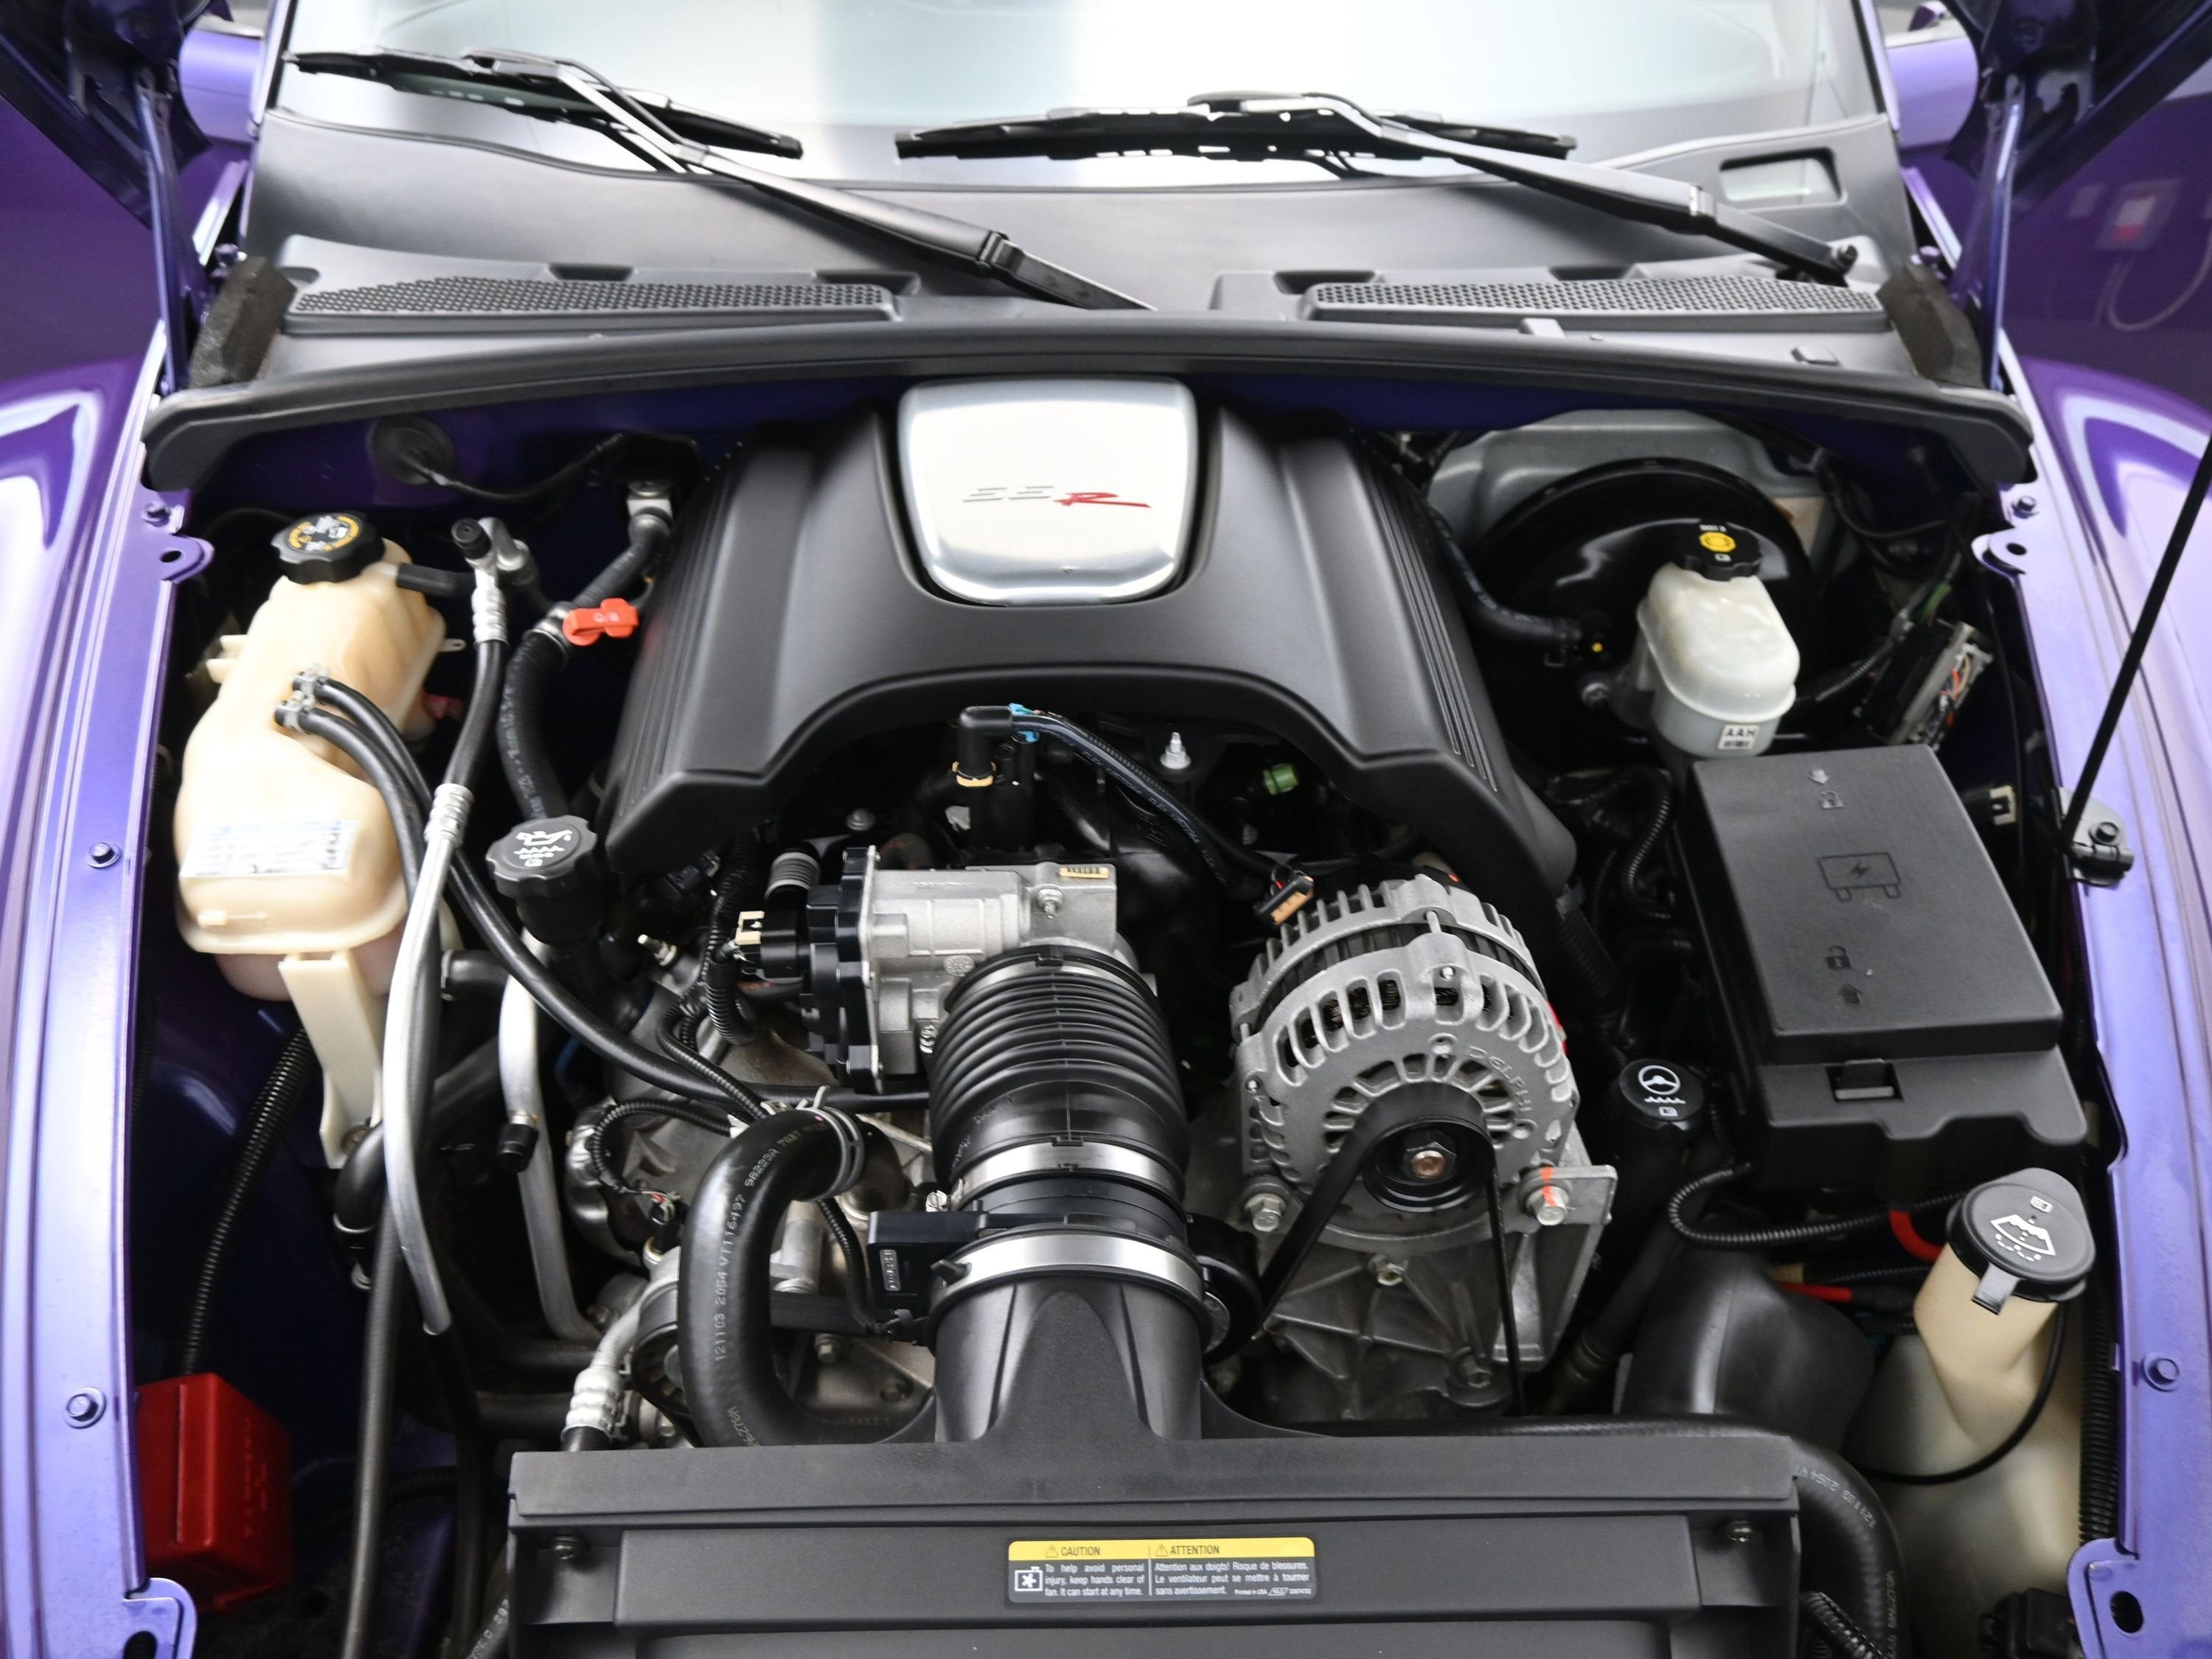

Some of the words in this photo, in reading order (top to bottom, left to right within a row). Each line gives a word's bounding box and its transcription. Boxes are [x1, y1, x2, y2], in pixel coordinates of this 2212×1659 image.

[963, 485, 1152, 509] SSR
[1464, 1046, 1532, 1112] DELPHI
[1060, 1546, 1101, 1557] CAUTION
[1169, 1545, 1220, 1555] ATTENTION
[1045, 1563, 1055, 1572] To
[1060, 1563, 1078, 1574] help
[1084, 1563, 1105, 1573] avoid
[1111, 1562, 1145, 1574] personal
[1155, 1562, 1188, 1572] Attention
[1232, 1561, 1258, 1572] Risque
[1259, 1561, 1270, 1571] de
[1069, 1575, 1088, 1585] keep
[1091, 1575, 1113, 1584] hands
[1116, 1574, 1134, 1584] clear
[1136, 1574, 1145, 1584] of
[1155, 1575, 1165, 1584] Le
[1168, 1574, 1208, 1584] ventilateur
[1211, 1574, 1228, 1585] peut
[1231, 1575, 1242, 1583] se
[1245, 1573, 1270, 1582] mettre
[1273, 1573, 1279, 1582] à
[1281, 1573, 1310, 1582] tourner
[1060, 1587, 1066, 1596] It
[1067, 1588, 1081, 1596] can
[1082, 1587, 1099, 1596] start
[1100, 1587, 1109, 1596] at
[1109, 1587, 1123, 1598] any
[1155, 1587, 1173, 1596] sans
[1174, 1585, 1228, 1596] avertissement.
